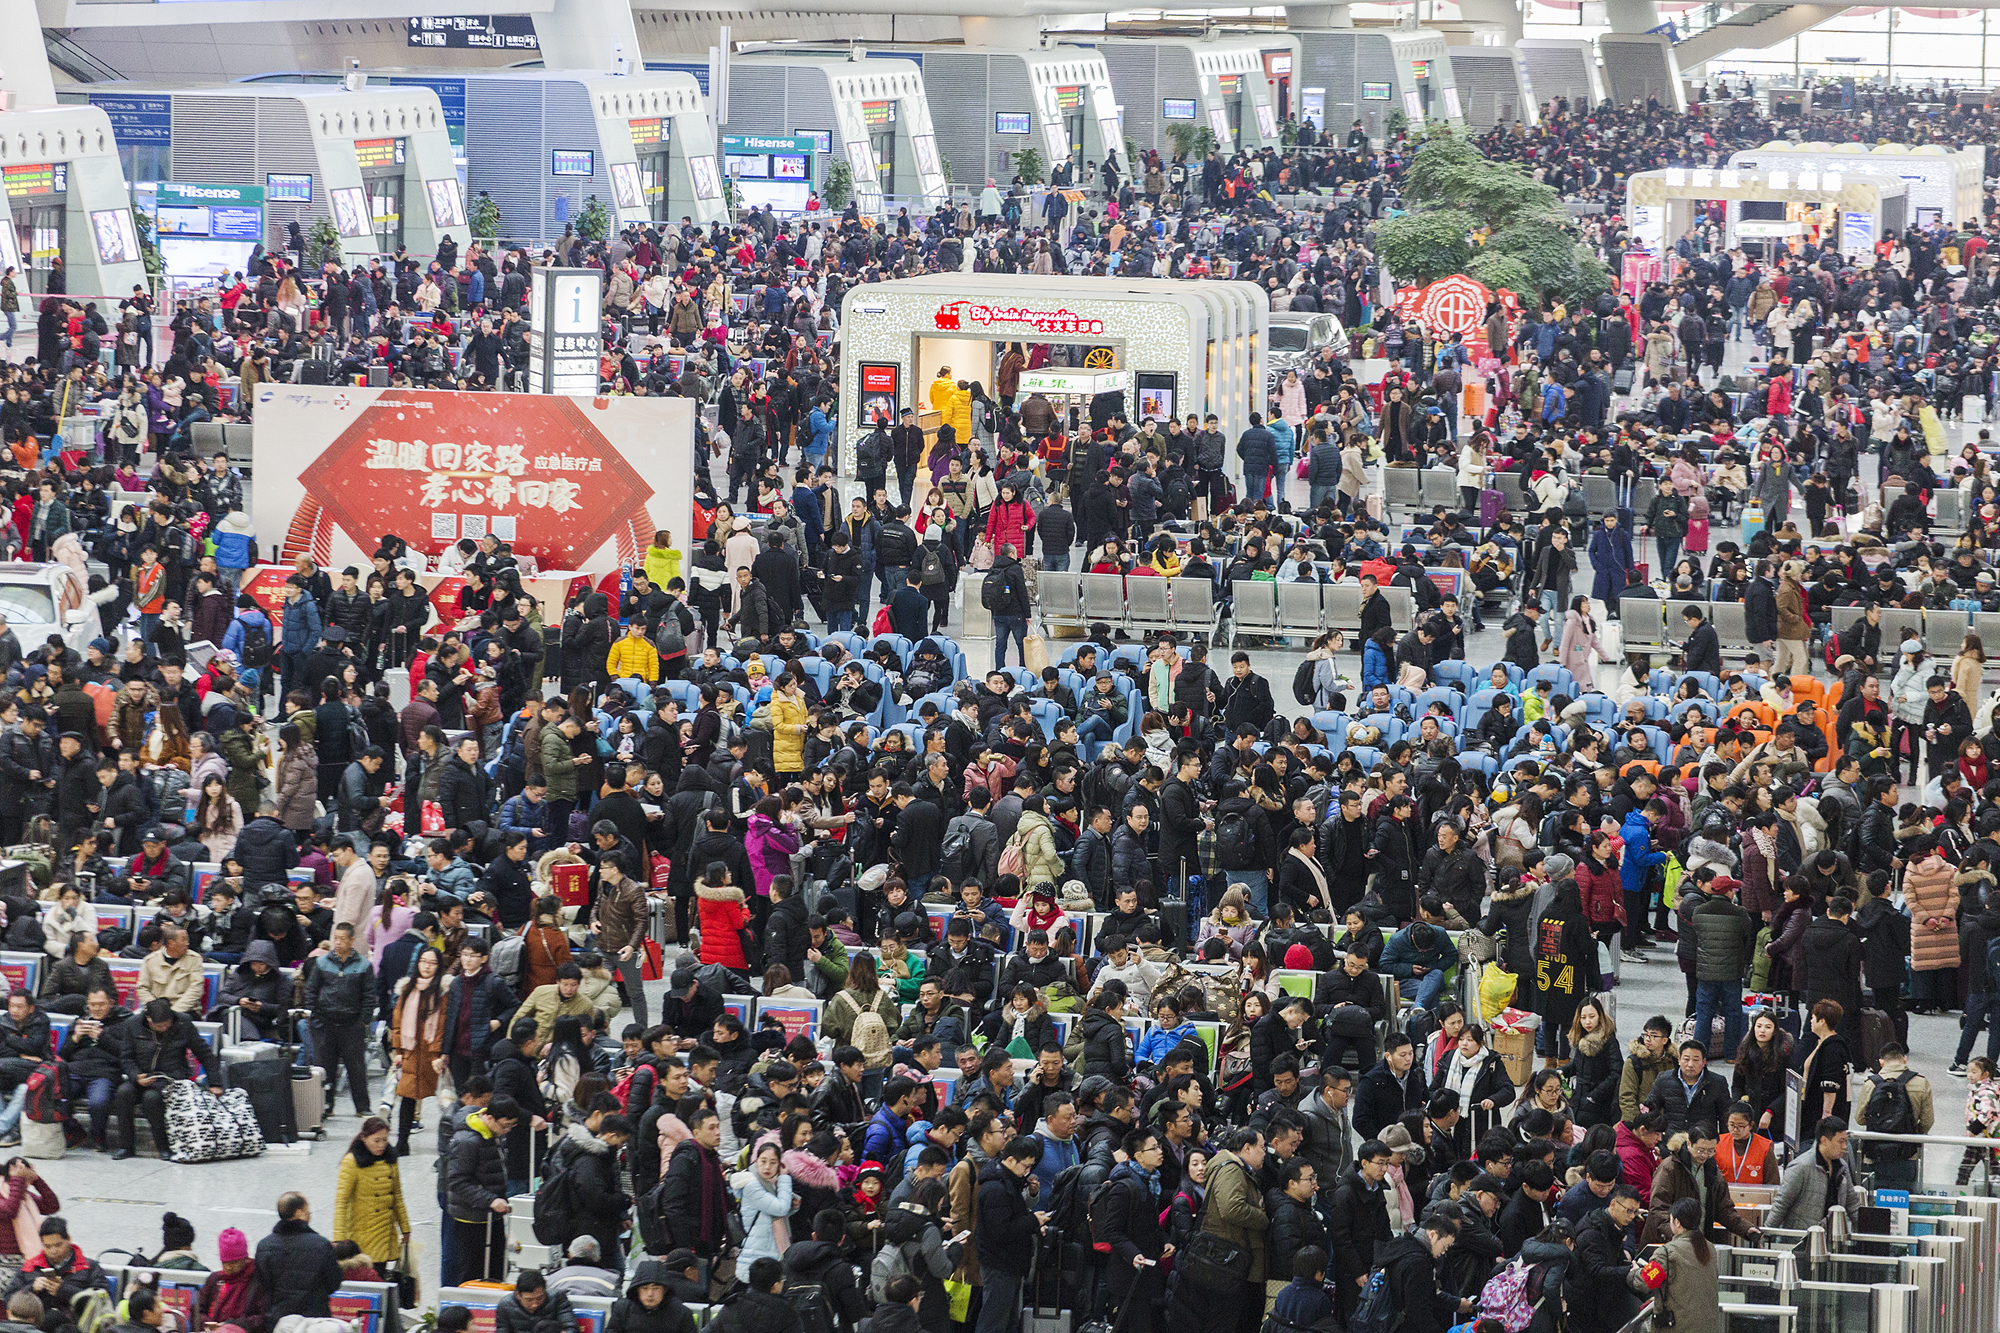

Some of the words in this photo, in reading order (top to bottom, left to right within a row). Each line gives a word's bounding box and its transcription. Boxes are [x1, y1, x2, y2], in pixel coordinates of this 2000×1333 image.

[744, 137, 795, 148] Hisense
[179, 186, 241, 199] Hisense
[971, 307, 991, 323] Big
[992, 307, 1021, 320] train
[1021, 309, 1077, 325] impression
[554, 336, 598, 350] 服务中心
[1026, 377, 1069, 388] 鲜果
[366, 439, 530, 476] 温暖回家路
[534, 455, 603, 472] 应急医疗点
[419, 472, 583, 513] 孝心带回家
[1541, 924, 1561, 932] STUDIO
[1537, 959, 1574, 995] 54
[1879, 1194, 1906, 1203] 自动开门
